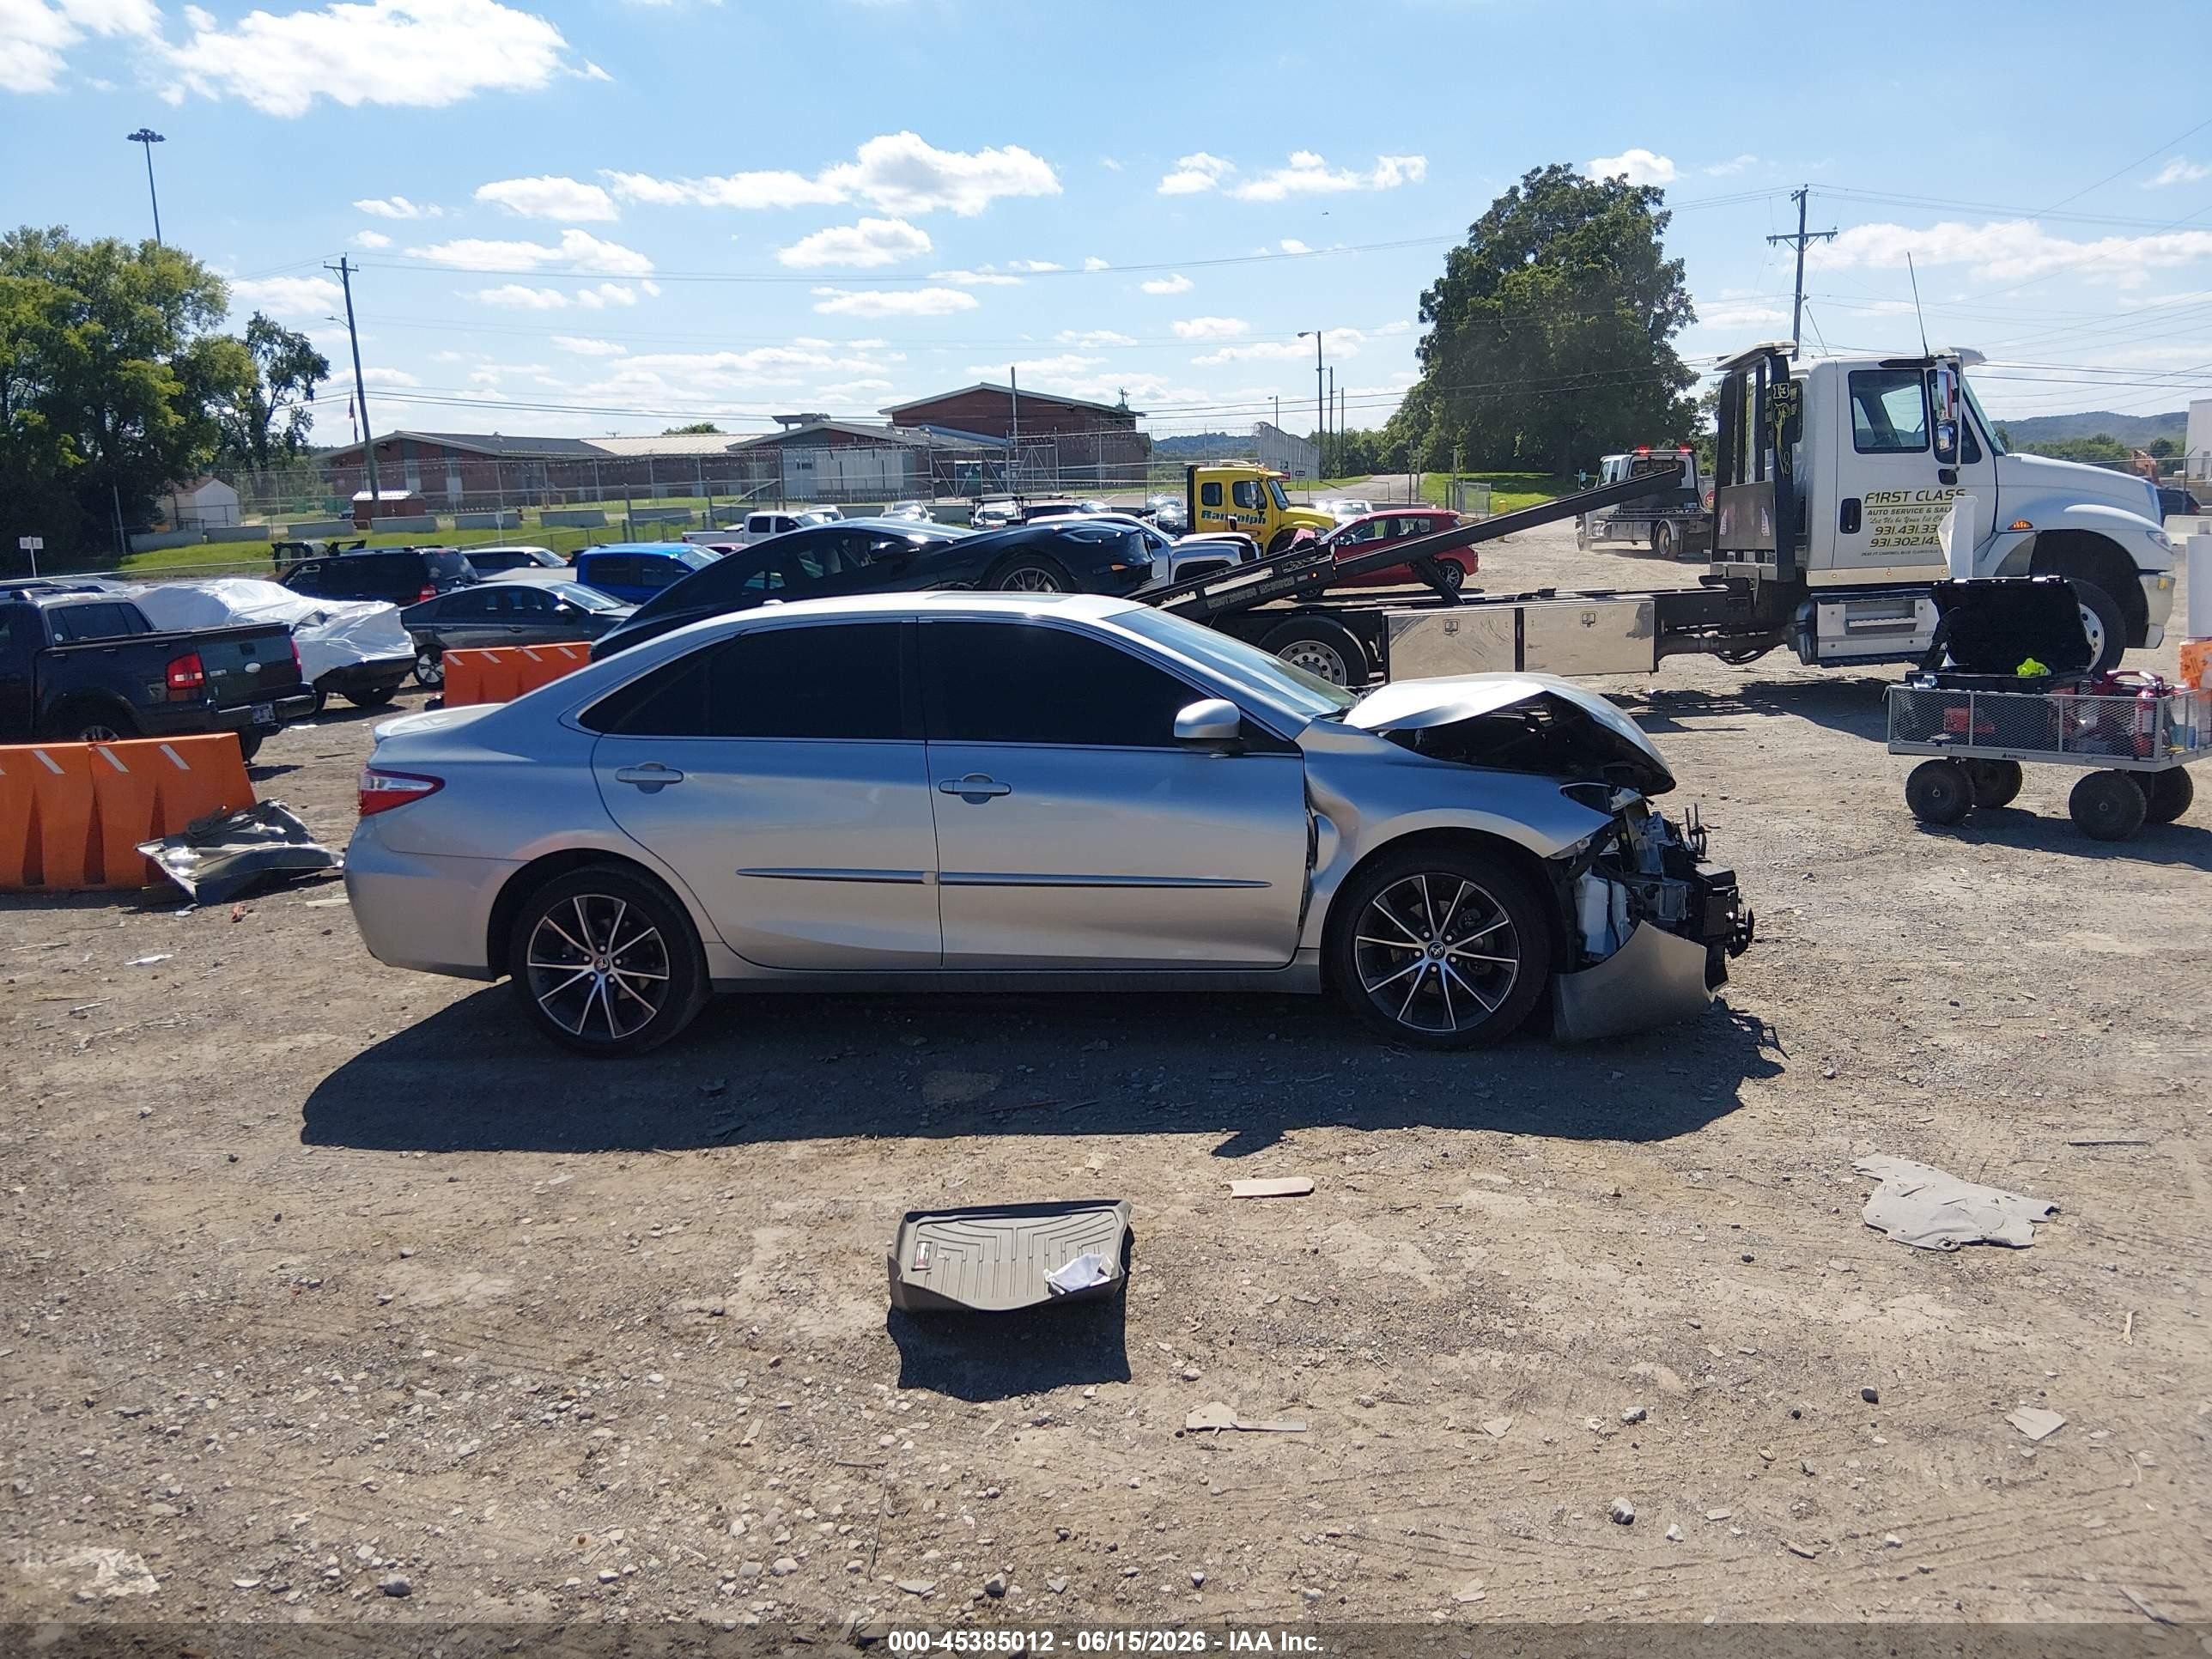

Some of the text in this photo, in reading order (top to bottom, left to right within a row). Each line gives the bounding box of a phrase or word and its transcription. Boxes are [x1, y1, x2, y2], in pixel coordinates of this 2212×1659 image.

[1773, 383, 1790, 398] 13
[1916, 489, 1966, 502] CLASS
[1201, 509, 1267, 525] Ranolph
[1875, 524, 1939, 536] 931.431.33
